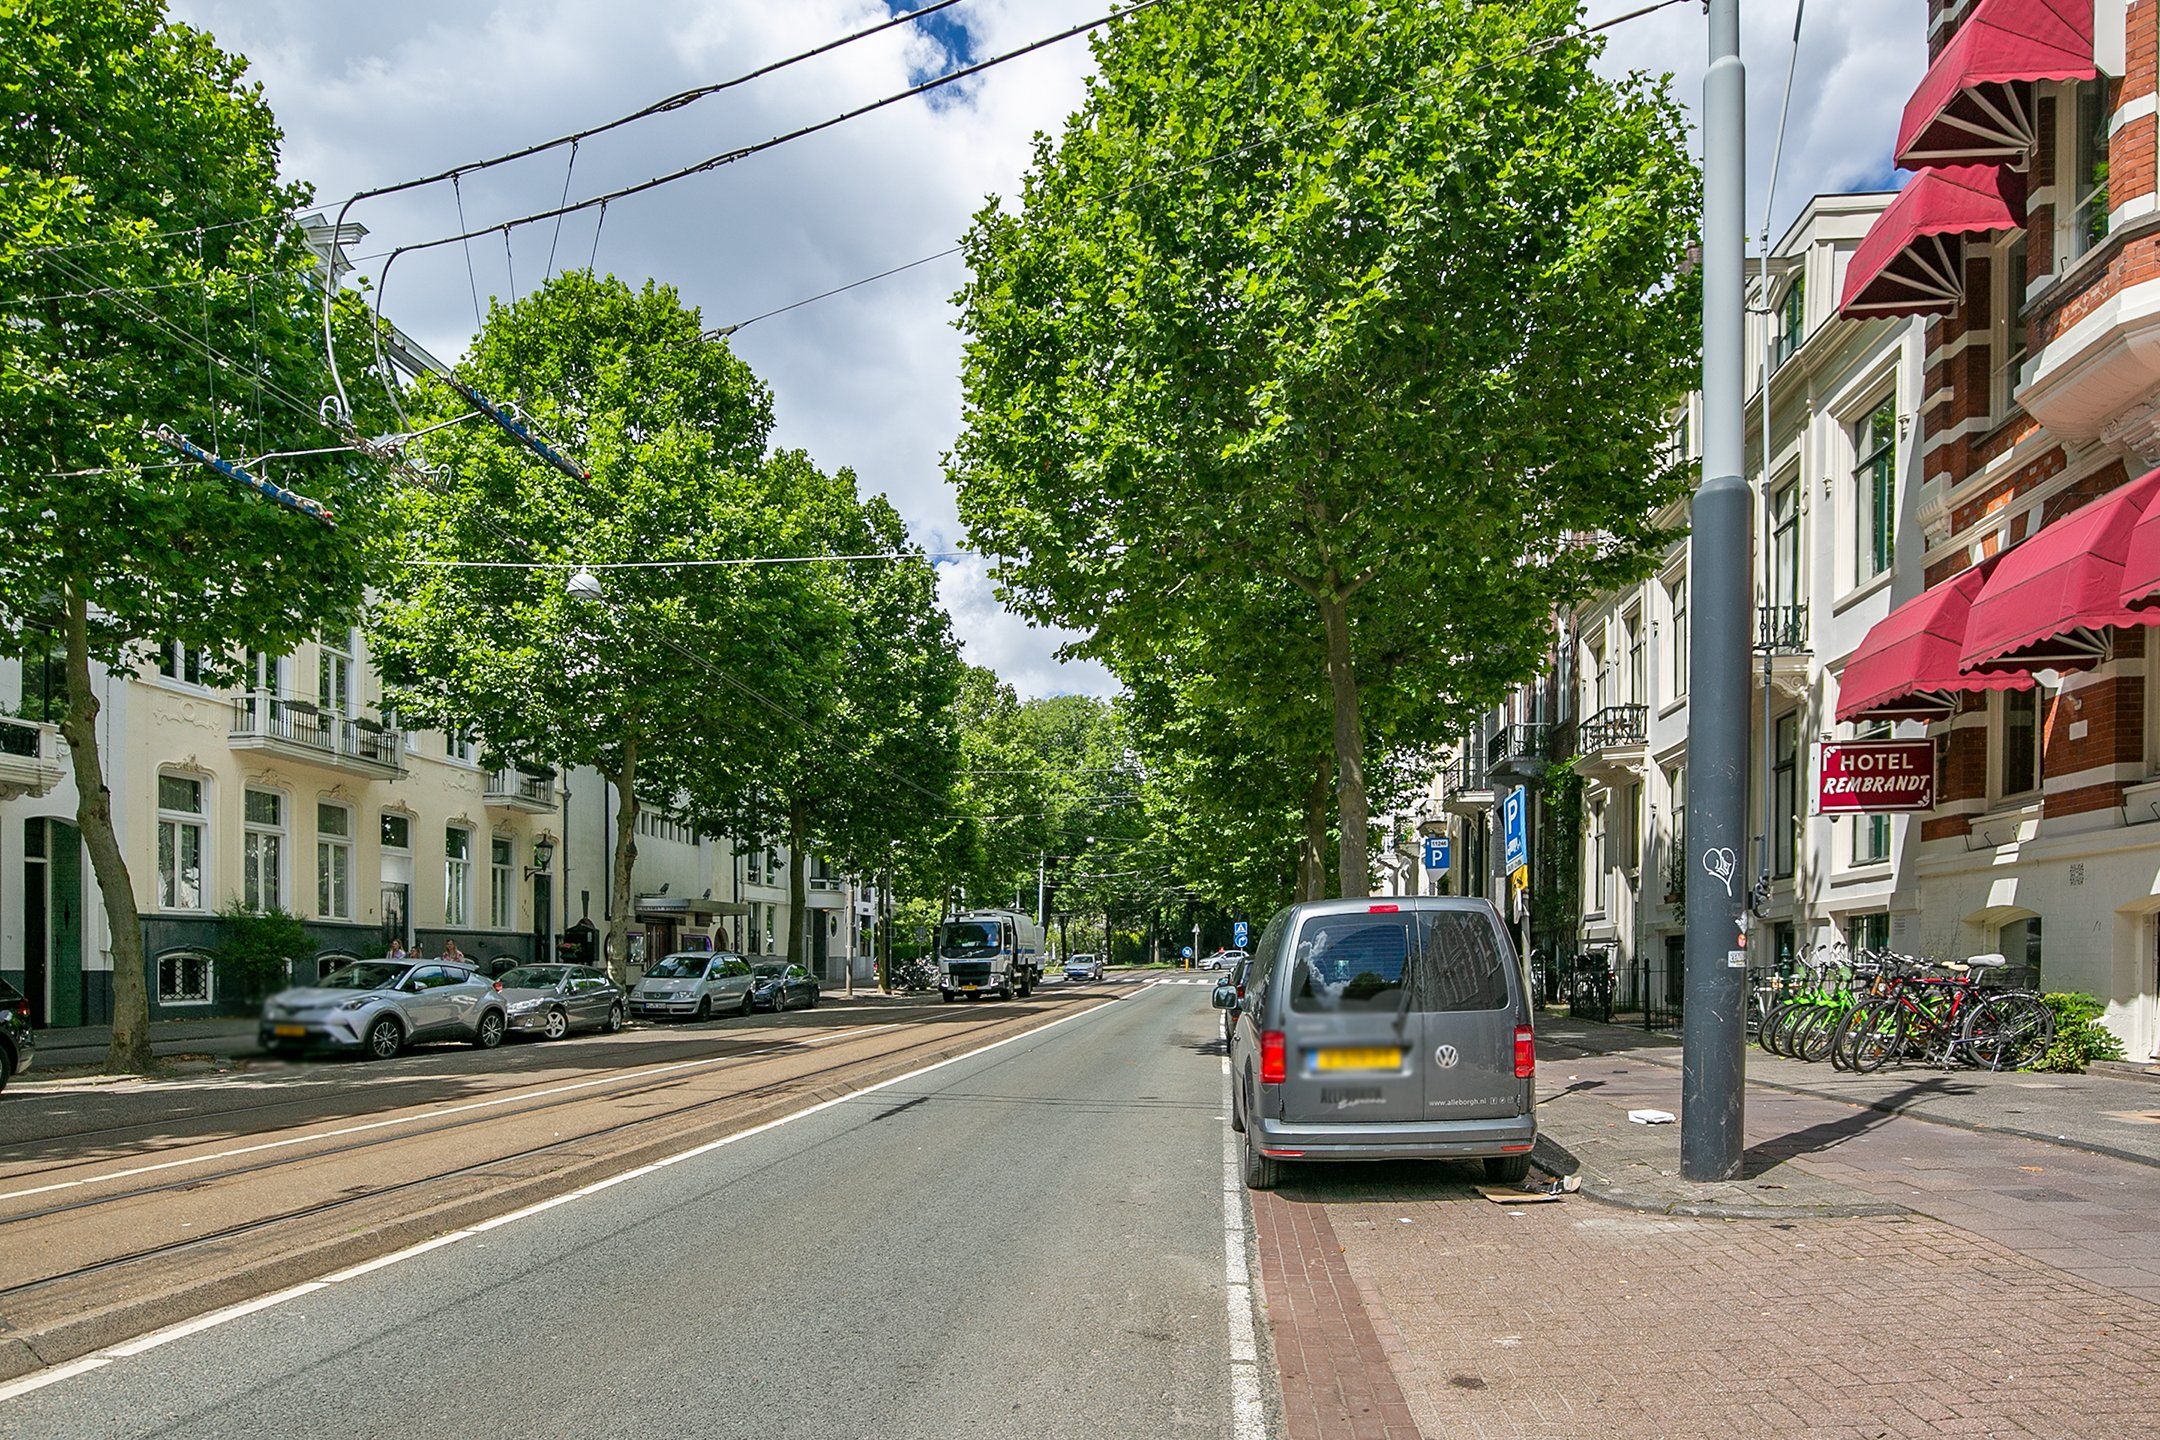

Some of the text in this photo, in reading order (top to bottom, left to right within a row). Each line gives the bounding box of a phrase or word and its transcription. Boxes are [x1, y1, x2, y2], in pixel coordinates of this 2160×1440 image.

[1840, 753, 1914, 771] HOTEL
[1823, 775, 1930, 794] REMBRANDT
[1507, 799, 1518, 835] P
[1432, 850, 1443, 867] P
[1429, 1098, 1487, 1106] www.alleborgh.nl
